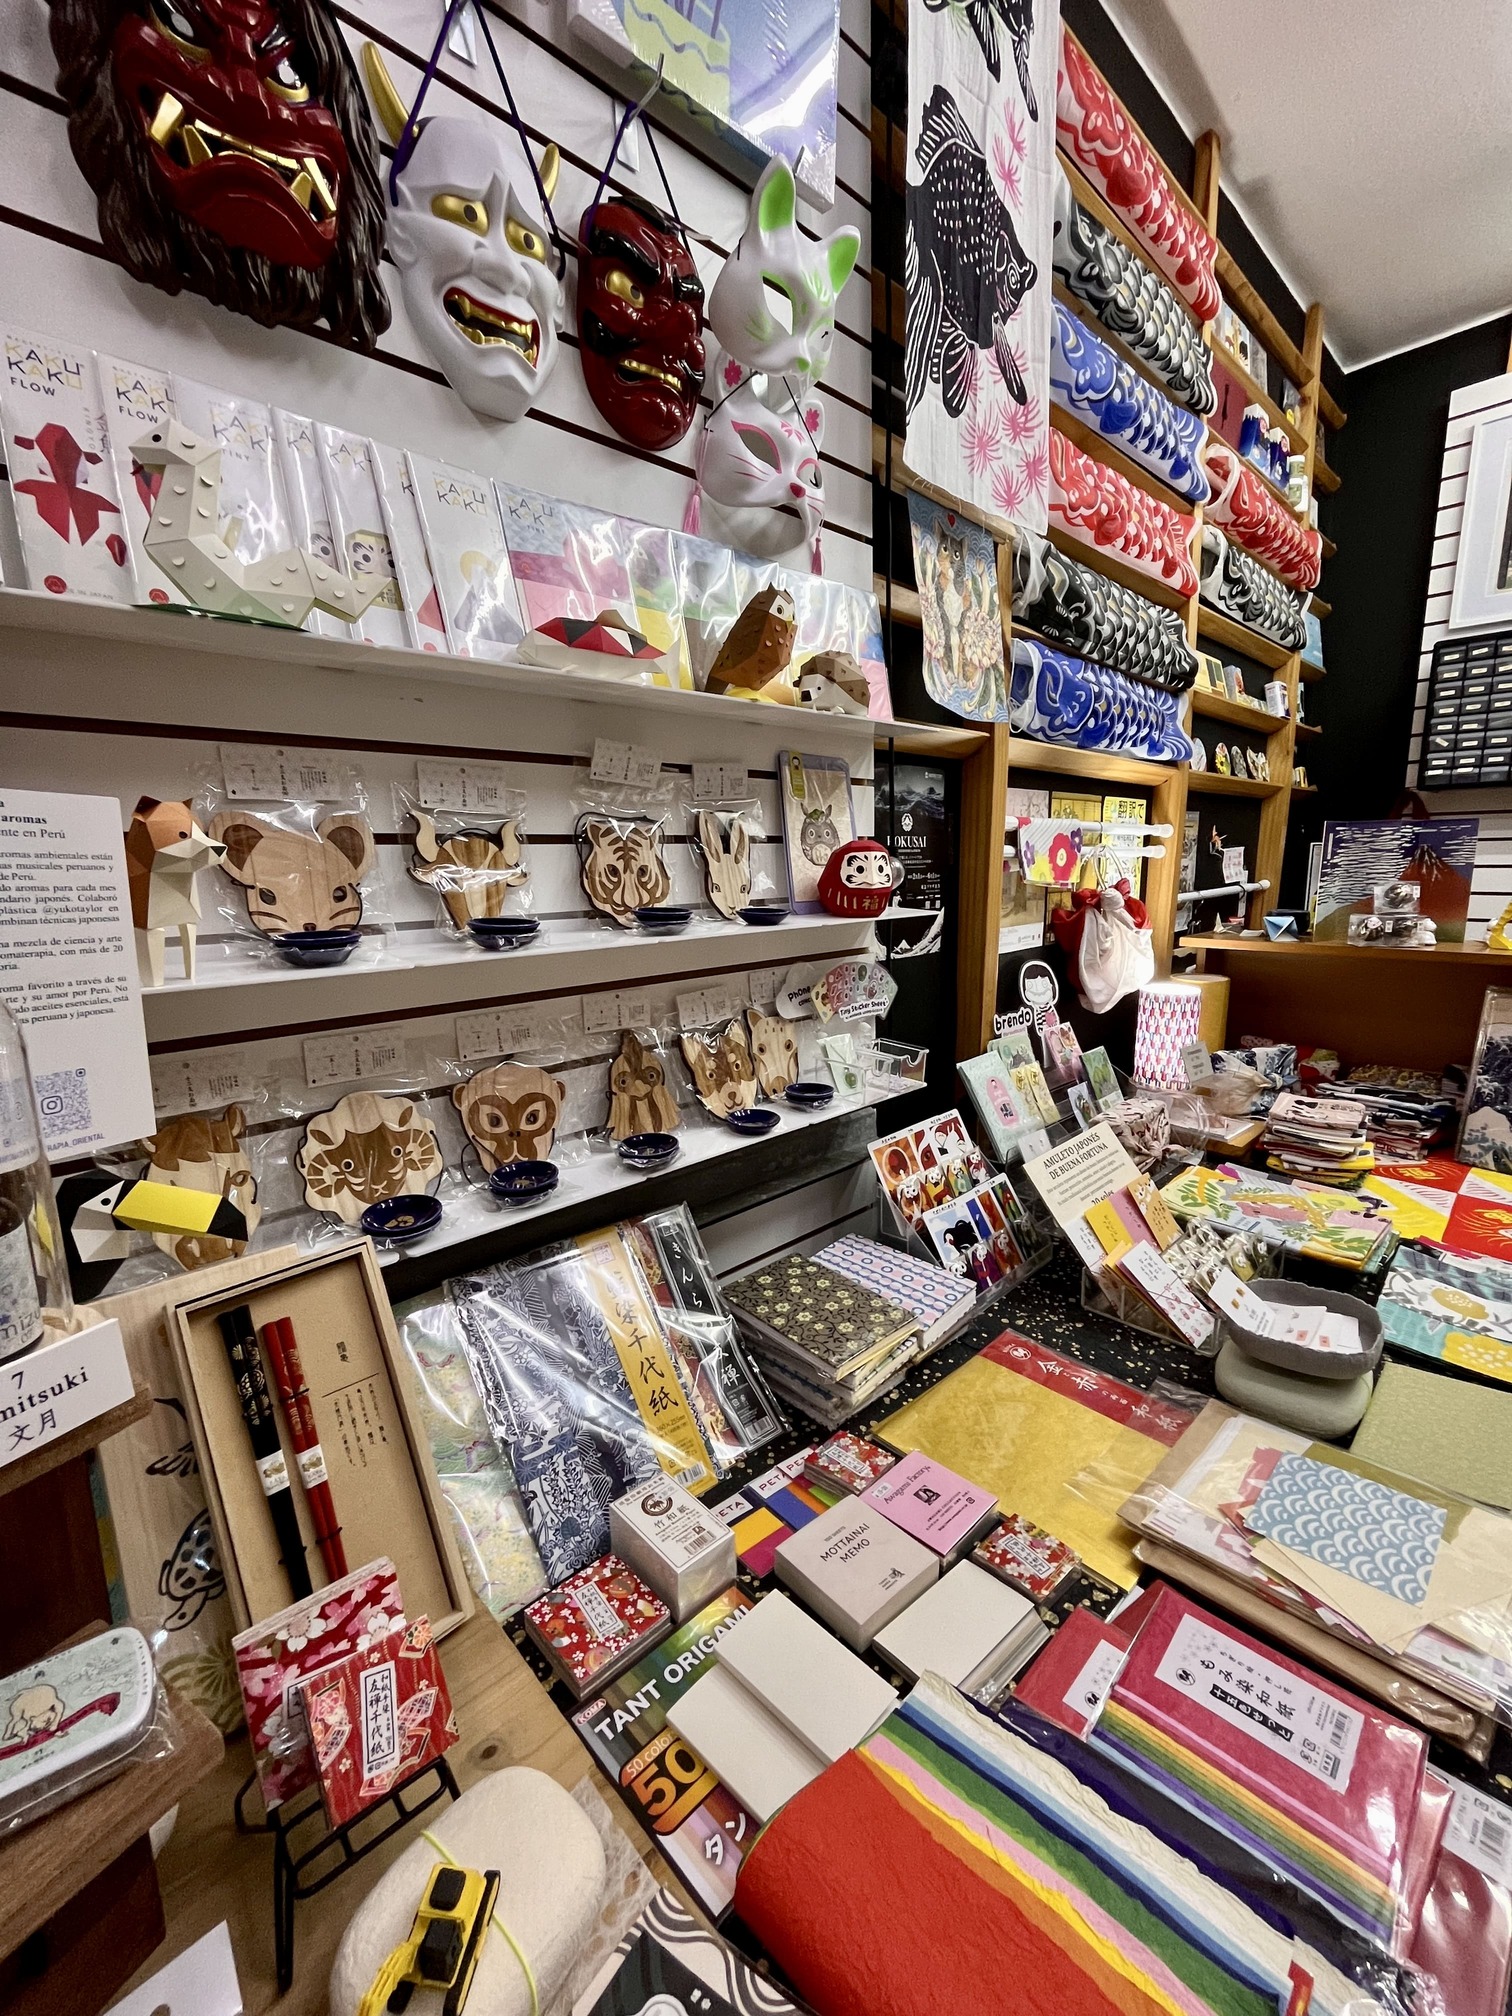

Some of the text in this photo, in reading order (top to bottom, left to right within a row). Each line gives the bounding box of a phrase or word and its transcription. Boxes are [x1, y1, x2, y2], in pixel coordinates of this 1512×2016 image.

[10, 376, 56, 397] FLOW
[118, 405, 159, 424] FLOW
[1, 814, 48, 824] aromas
[23, 830, 37, 838] en
[40, 829, 66, 839] Perú
[34, 851, 89, 860] ambientales
[16, 862, 63, 871] musicales
[53, 885, 73, 894] para
[76, 884, 97, 892] cada
[77, 893, 118, 902] Colaboró
[43, 904, 103, 915] @yukotaylor
[862, 895, 879, 911] 福
[40, 915, 77, 925] técnicas
[78, 914, 120, 925] japonesas
[13, 938, 48, 948] mezcla
[50, 937, 61, 946] de
[64, 936, 96, 945] ciencia
[106, 935, 123, 943] arte
[79, 947, 97, 955] más
[100, 945, 110, 953] de
[113, 944, 124, 952] 20
[28, 981, 65, 991] favorito
[67, 980, 74, 988] a
[76, 977, 102, 986] través
[104, 975, 115, 983] de
[32, 994, 43, 1002] su
[46, 991, 69, 1000] amor
[72, 989, 88, 998] por
[116, 984, 128, 992] No
[31, 1001, 64, 1012] aceites
[65, 997, 112, 1009] esenciales,
[113, 994, 130, 1003] está
[31, 1012, 68, 1024] peruana
[994, 1009, 1032, 1032] brendo
[1043, 1132, 1101, 1169] AMULETO JAPONÉS
[1049, 1142, 1109, 1180] DE BUENA FORTUNA
[11, 1371, 25, 1390] 7
[9, 1408, 58, 1452] 文月
[715, 1500, 745, 1519] ETA
[819, 1522, 870, 1562] MOTTAINAI
[839, 1538, 870, 1563] MEMO
[1199, 1658, 1297, 1721] もみ染和紙
[578, 1700, 606, 1725] KOMA
[593, 1678, 662, 1741] TANT
[626, 1757, 645, 1779] 50
[630, 1738, 708, 1817] 50
